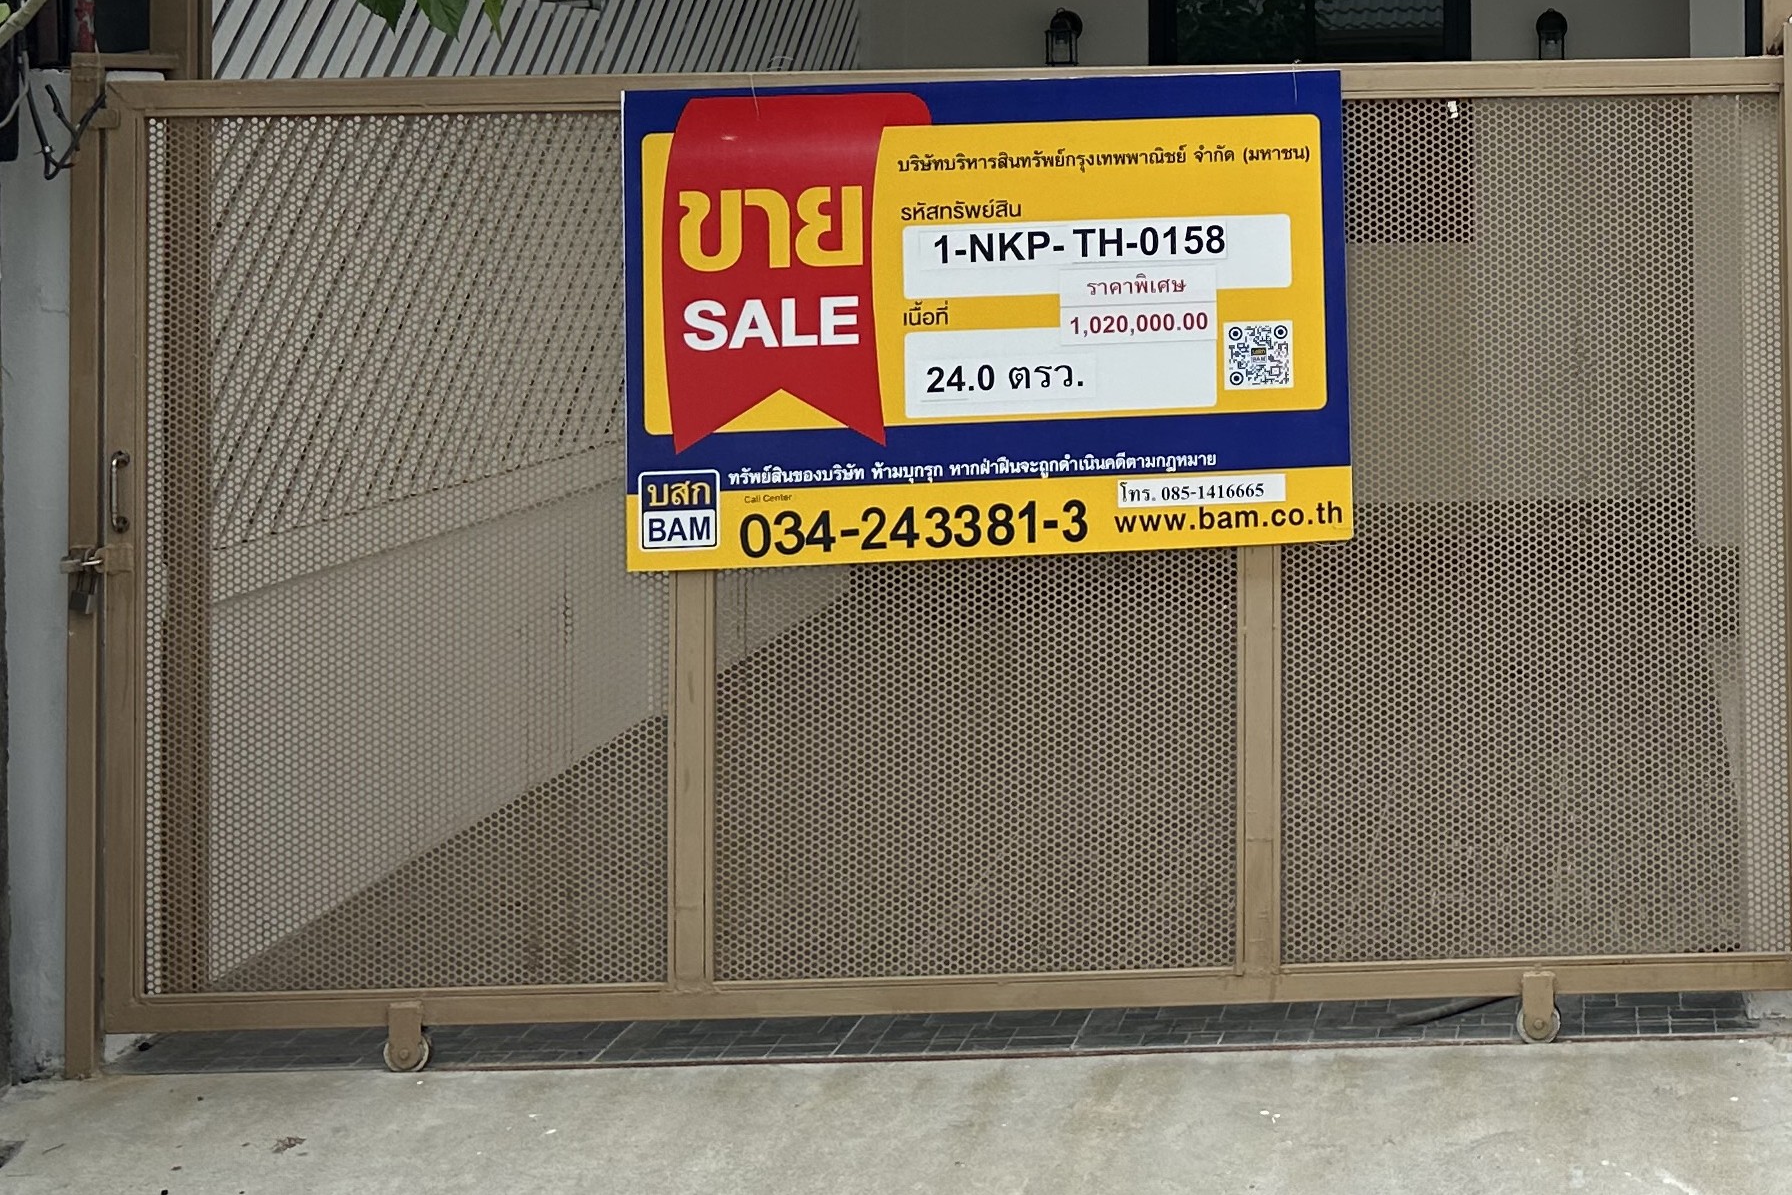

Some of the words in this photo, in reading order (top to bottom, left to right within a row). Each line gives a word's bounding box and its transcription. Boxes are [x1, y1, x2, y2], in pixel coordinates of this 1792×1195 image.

[898, 144, 1188, 173] บริษัทบริหารสินทรัพย์กรุงเทพพาณิชย์
[1193, 144, 1235, 163] จำกัด
[1243, 145, 1311, 165] (มหาชน)
[900, 199, 1022, 221] รหัสทรัพย์สิน
[678, 185, 864, 273] ขาย
[1086, 273, 1187, 296] ราคาพิเศษ
[682, 295, 860, 352] SALE
[902, 301, 949, 326] เนื้อที่
[1069, 311, 1209, 337] 1,020,000.00
[926, 364, 996, 393] 24.0
[1008, 363, 1085, 390] ตรว.
[728, 464, 865, 486] ทรัพย์สินของบริษัท
[871, 461, 943, 483] ห้ามบุกรุก
[949, 452, 1217, 478] หากฝ่าฝืนจะถูกดำเนินคดีตามกฎหมาย
[647, 480, 711, 507] บสก
[744, 495, 761, 504] Call
[762, 493, 793, 503] Center
[1119, 482, 1157, 503] โทร.
[1161, 482, 1265, 501] 085-1416665
[648, 516, 711, 542] BAM
[739, 498, 1089, 559] 034-243381-3
[1114, 501, 1343, 533] www.bam.co.th
